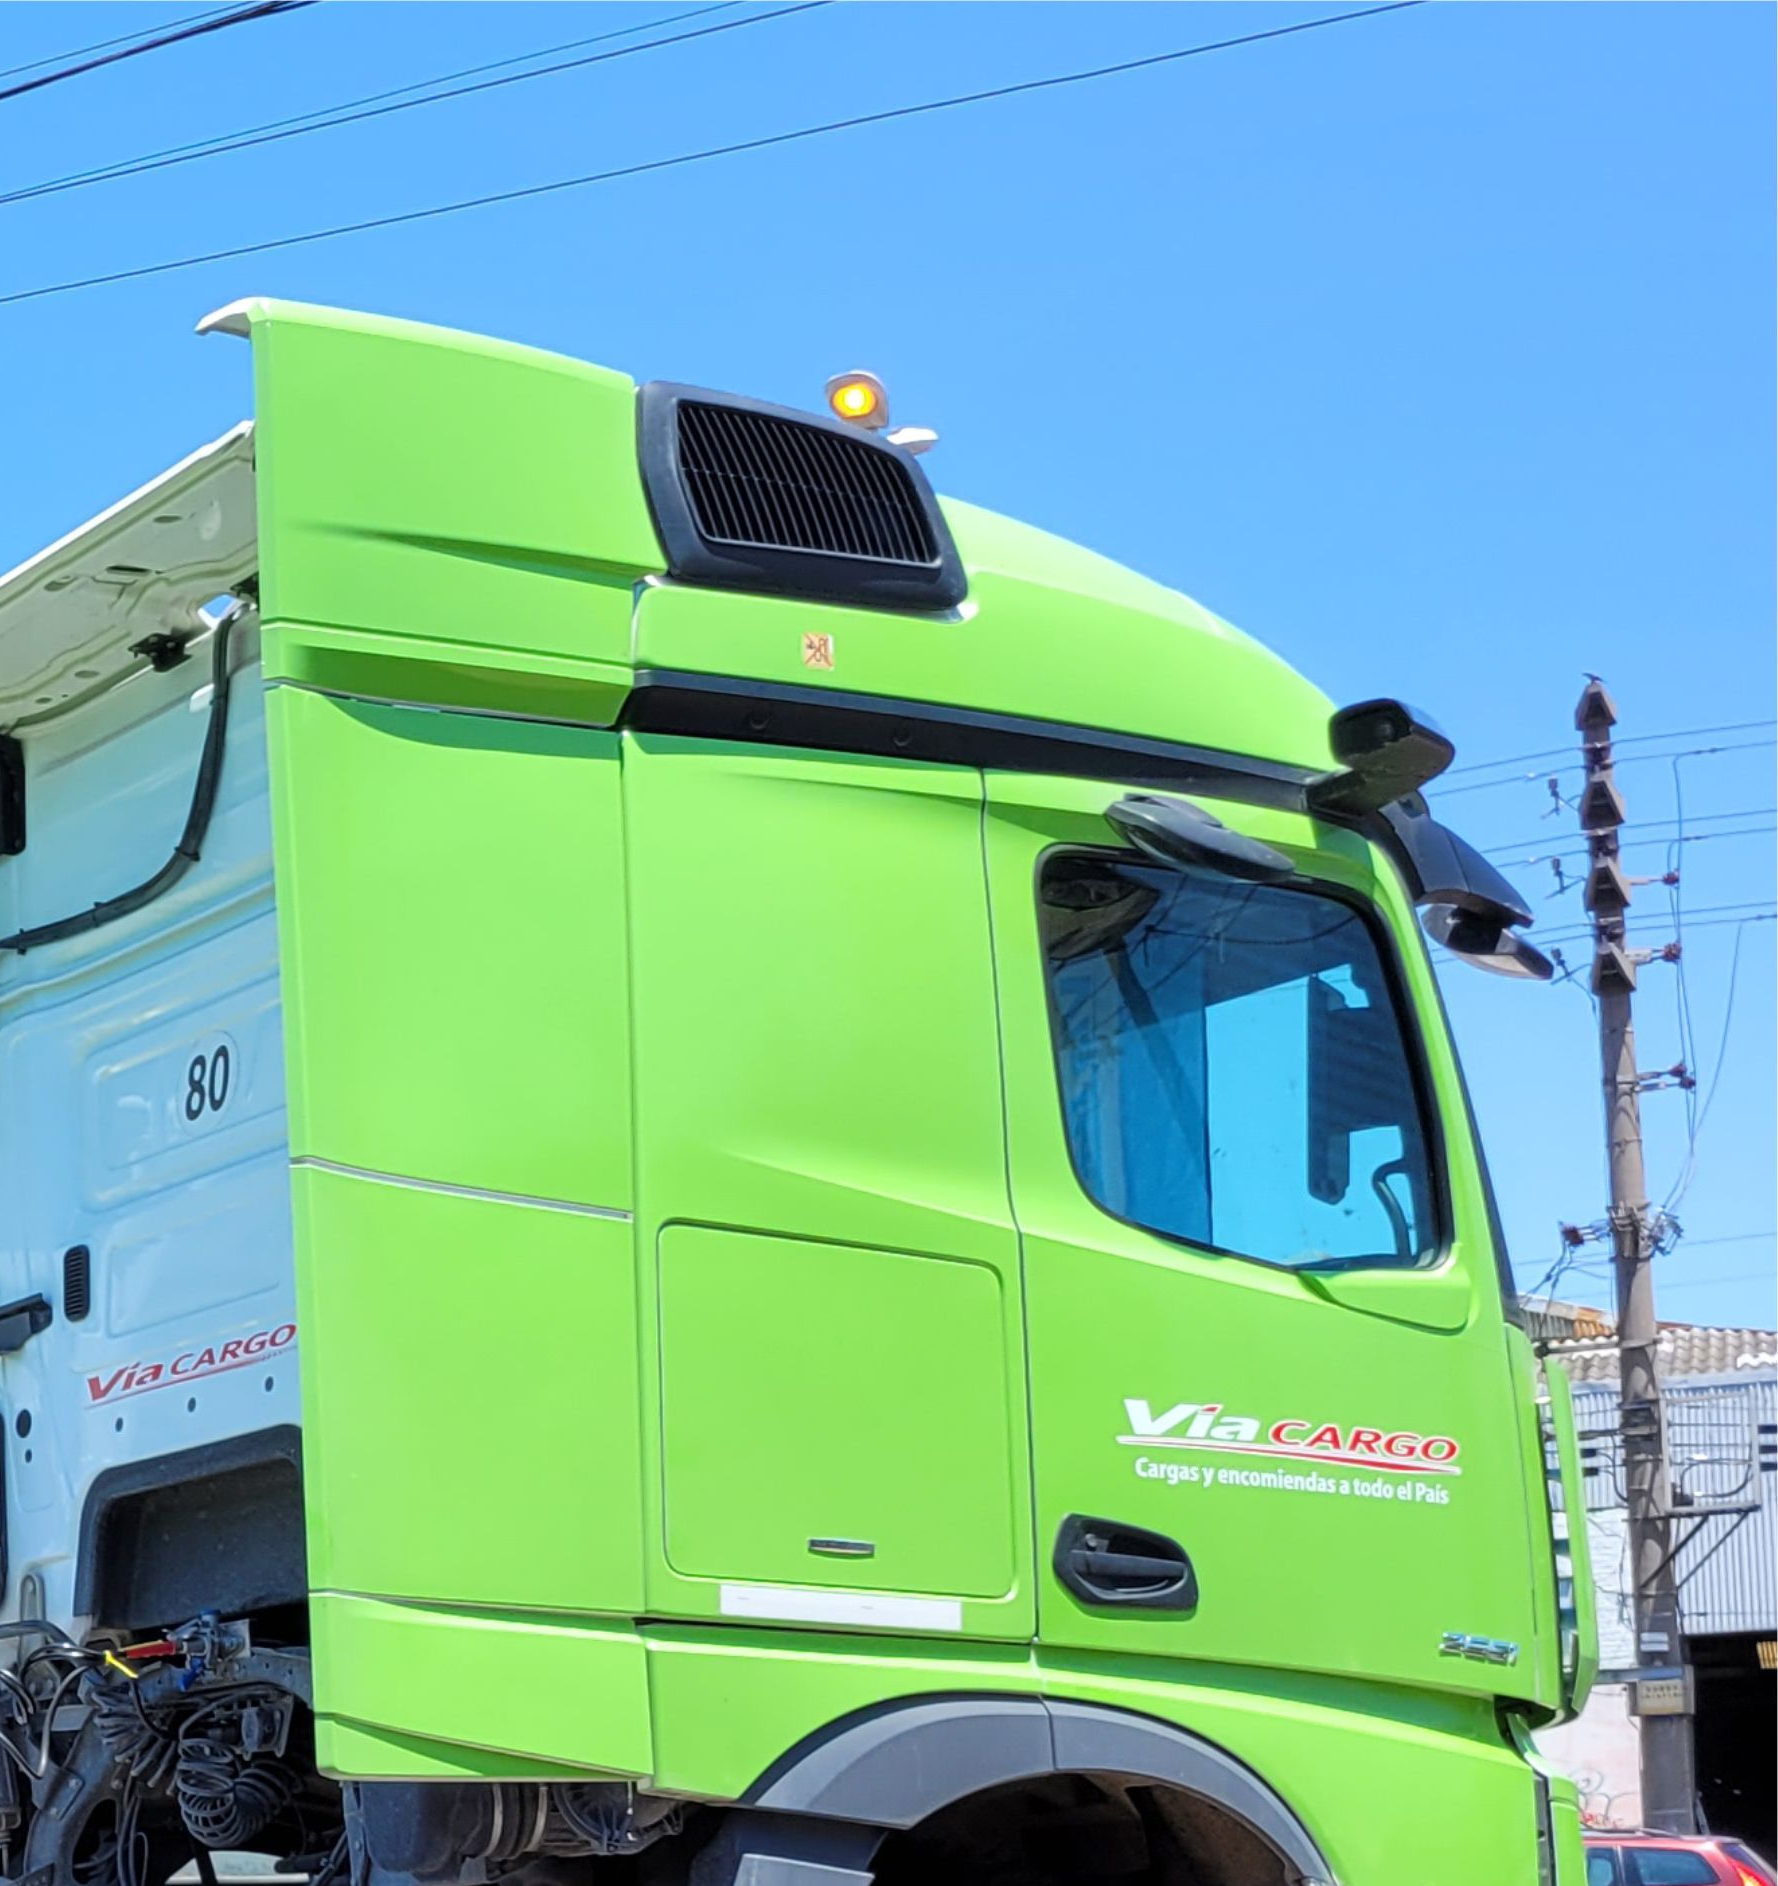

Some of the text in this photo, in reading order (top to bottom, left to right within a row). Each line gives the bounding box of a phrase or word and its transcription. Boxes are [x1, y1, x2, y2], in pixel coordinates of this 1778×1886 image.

[185, 1045, 229, 1121] 80
[170, 1324, 297, 1376] CARGO
[1269, 1420, 1458, 1462] CARGO
[1135, 1457, 1199, 1485] Cargas
[1202, 1465, 1214, 1488] y
[1218, 1466, 1336, 1494] encomiendas
[1340, 1482, 1350, 1495] a
[1353, 1478, 1393, 1500] todo
[1397, 1482, 1412, 1500] el
